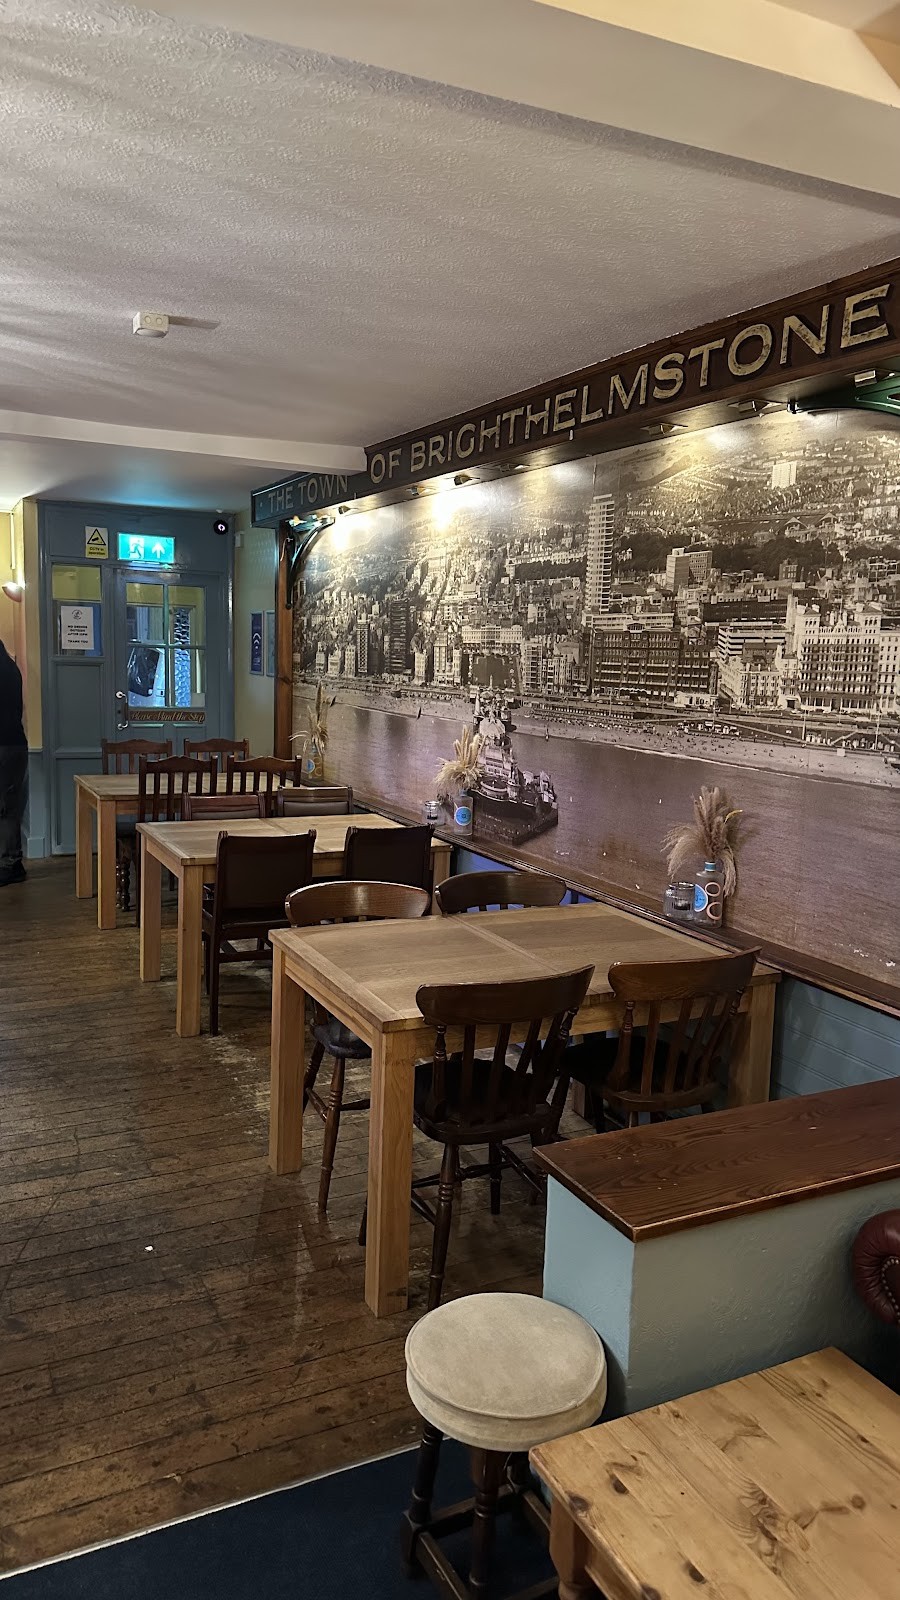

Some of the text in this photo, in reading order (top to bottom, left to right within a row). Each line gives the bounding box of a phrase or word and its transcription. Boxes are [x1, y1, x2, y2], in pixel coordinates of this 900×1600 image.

[268, 283, 891, 513] THE TOWN OF BRIGHTHELMSTONE
